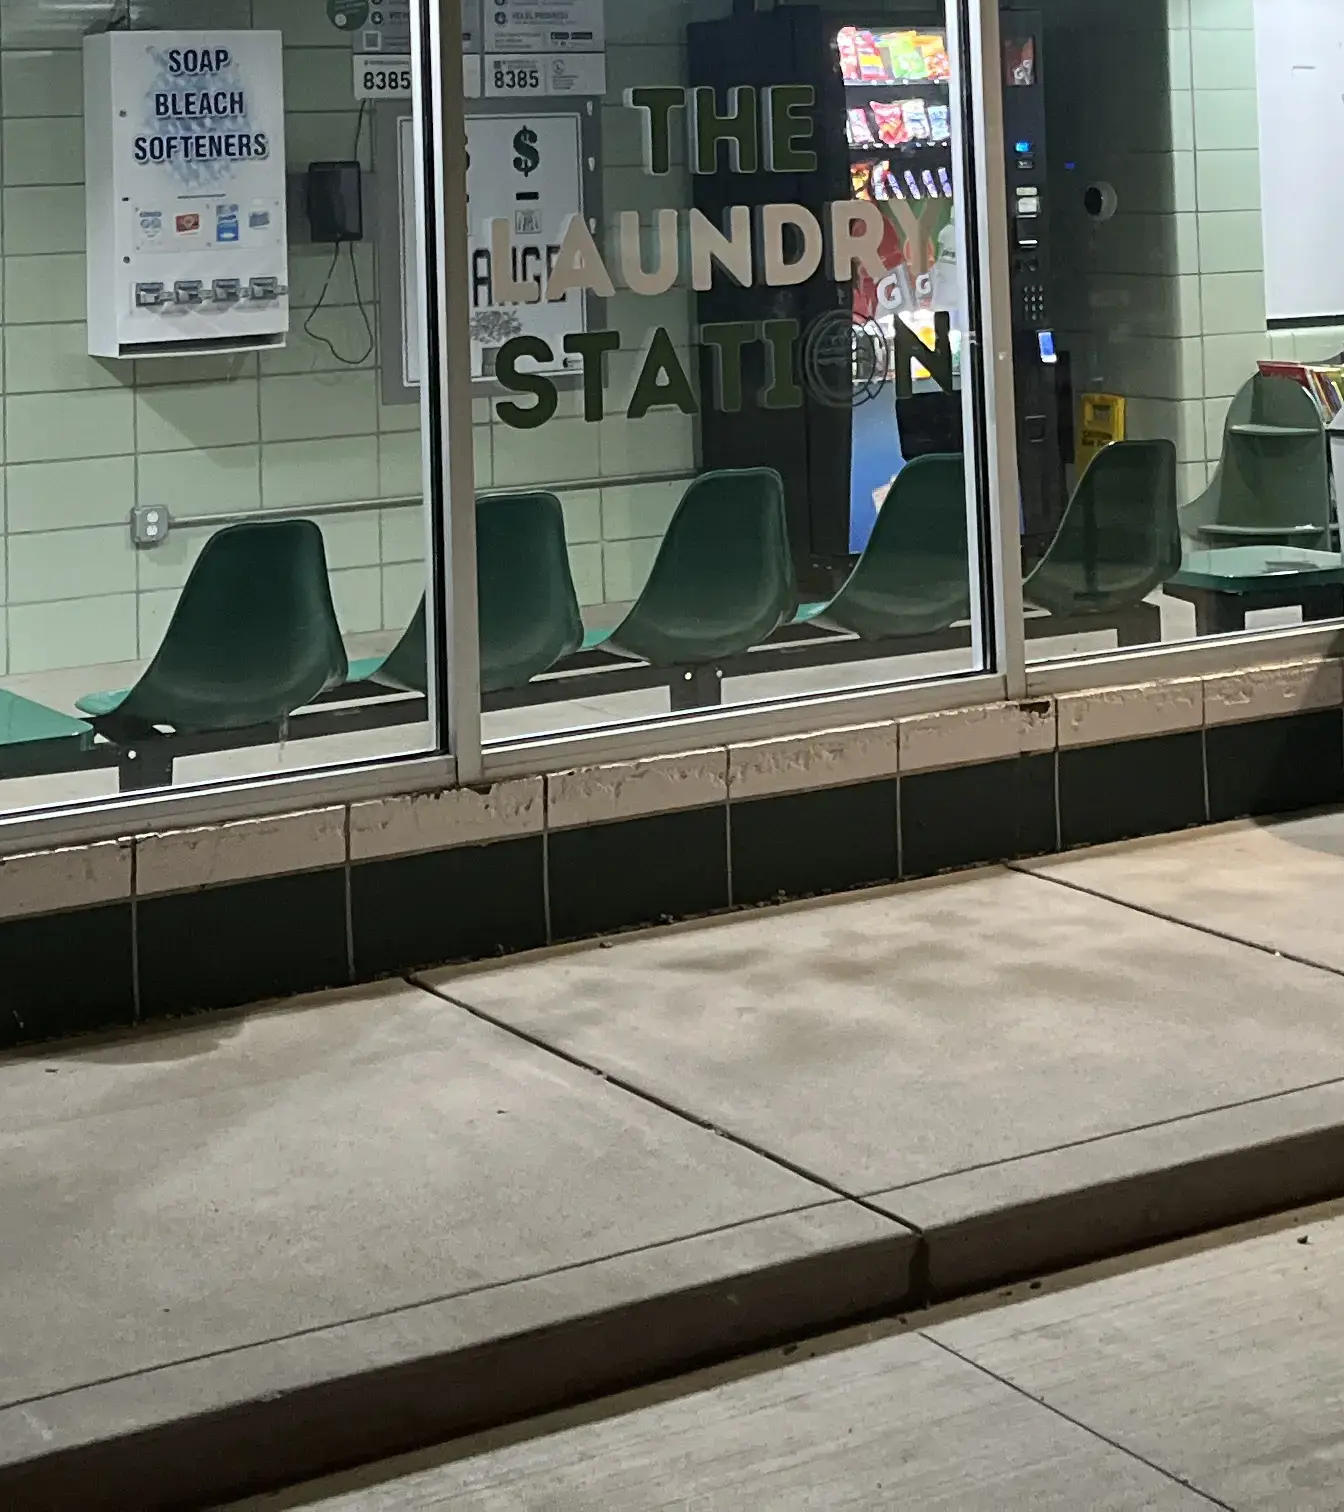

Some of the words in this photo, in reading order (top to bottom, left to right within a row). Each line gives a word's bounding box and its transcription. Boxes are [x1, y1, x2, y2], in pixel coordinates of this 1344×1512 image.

[168, 49, 230, 73] SOAP
[363, 71, 411, 90] 8385
[494, 70, 539, 89] 8385
[155, 91, 244, 117] BLEACH
[631, 85, 817, 174] THE
[134, 133, 267, 161] SOFTENERS
[491, 199, 943, 304] LAUNDRY
[495, 308, 953, 430] STATION
